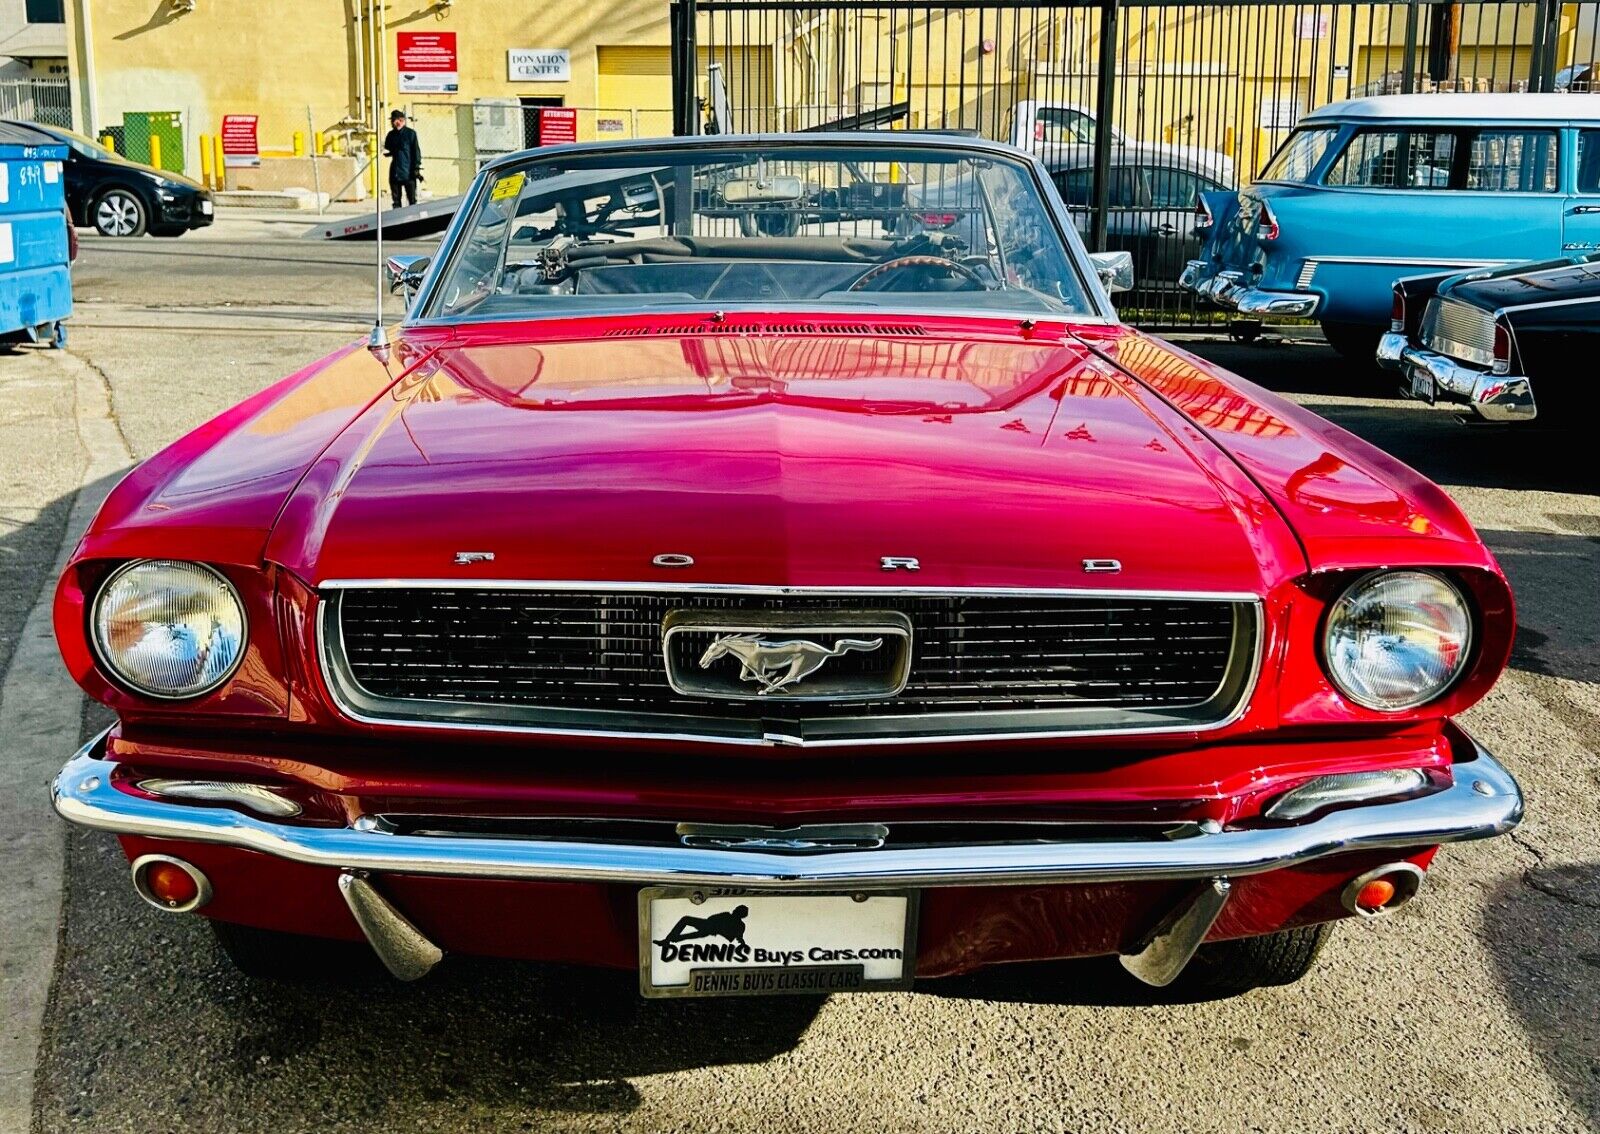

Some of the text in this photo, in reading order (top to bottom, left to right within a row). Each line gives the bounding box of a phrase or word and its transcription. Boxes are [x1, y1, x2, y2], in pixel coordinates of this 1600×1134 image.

[512, 55, 567, 64] DONATION
[518, 65, 561, 74] CENTER
[660, 943, 902, 966] DENNIS Buys Cars.com
[694, 971, 860, 992] DENNIS BUYS CLASSIC CARS
